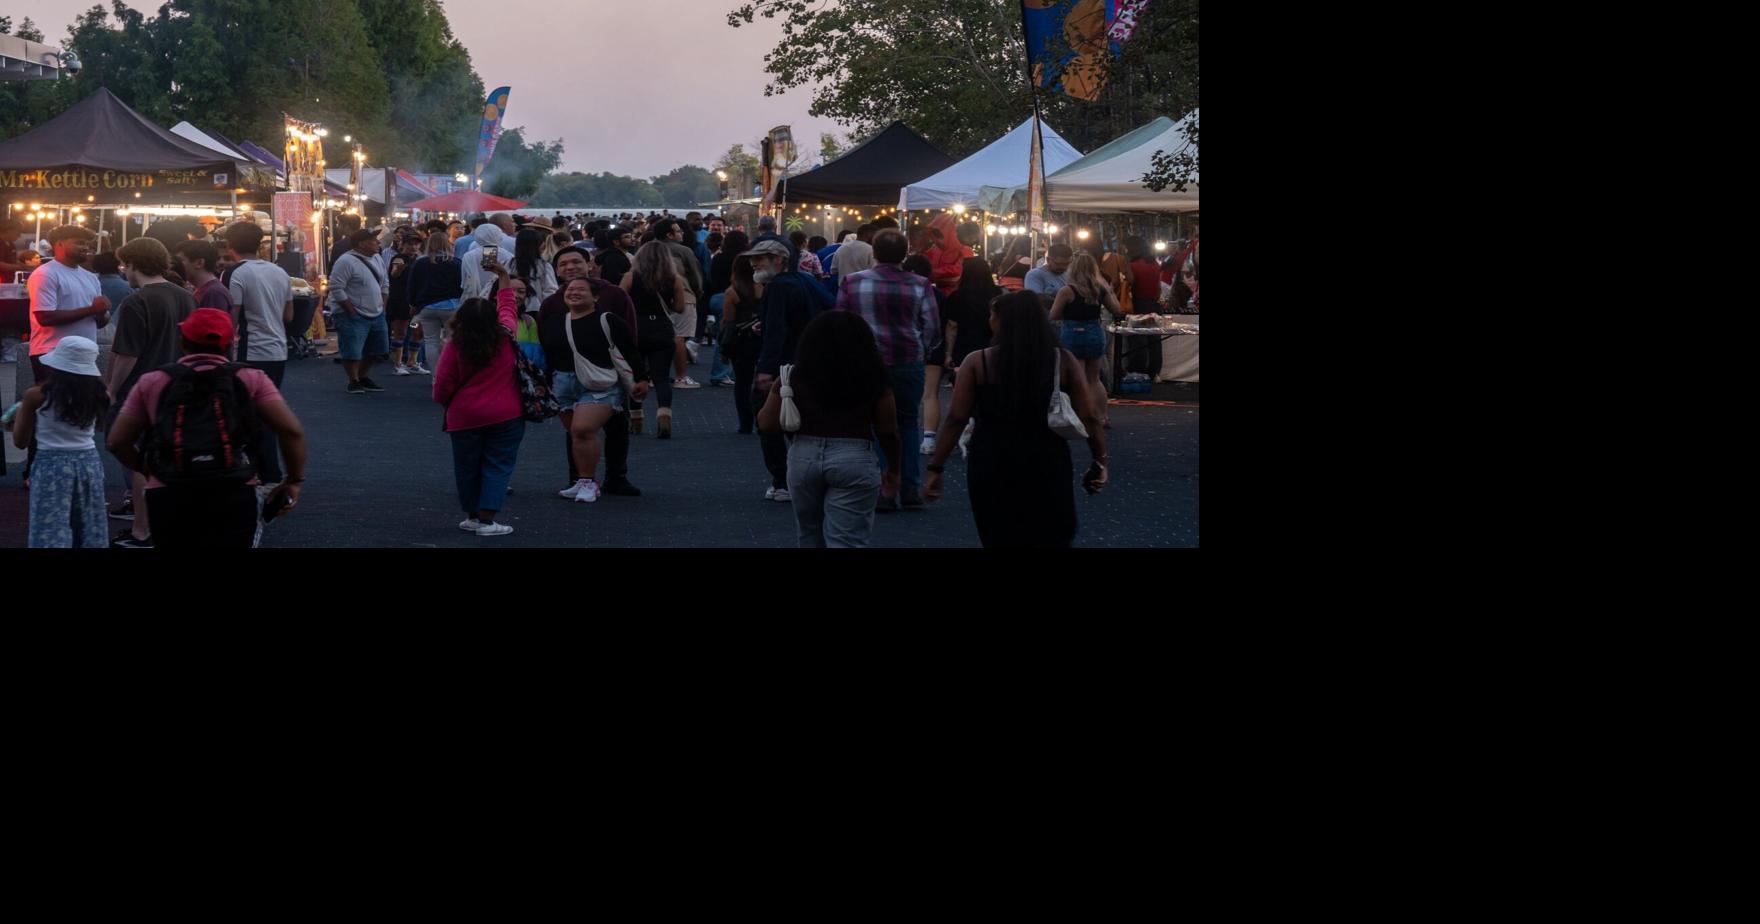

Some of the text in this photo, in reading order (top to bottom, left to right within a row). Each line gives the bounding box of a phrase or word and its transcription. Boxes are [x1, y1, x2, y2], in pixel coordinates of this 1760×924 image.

[36, 170, 99, 188] Kettle
[103, 170, 154, 189] Corn
[166, 177, 199, 187] Salty
